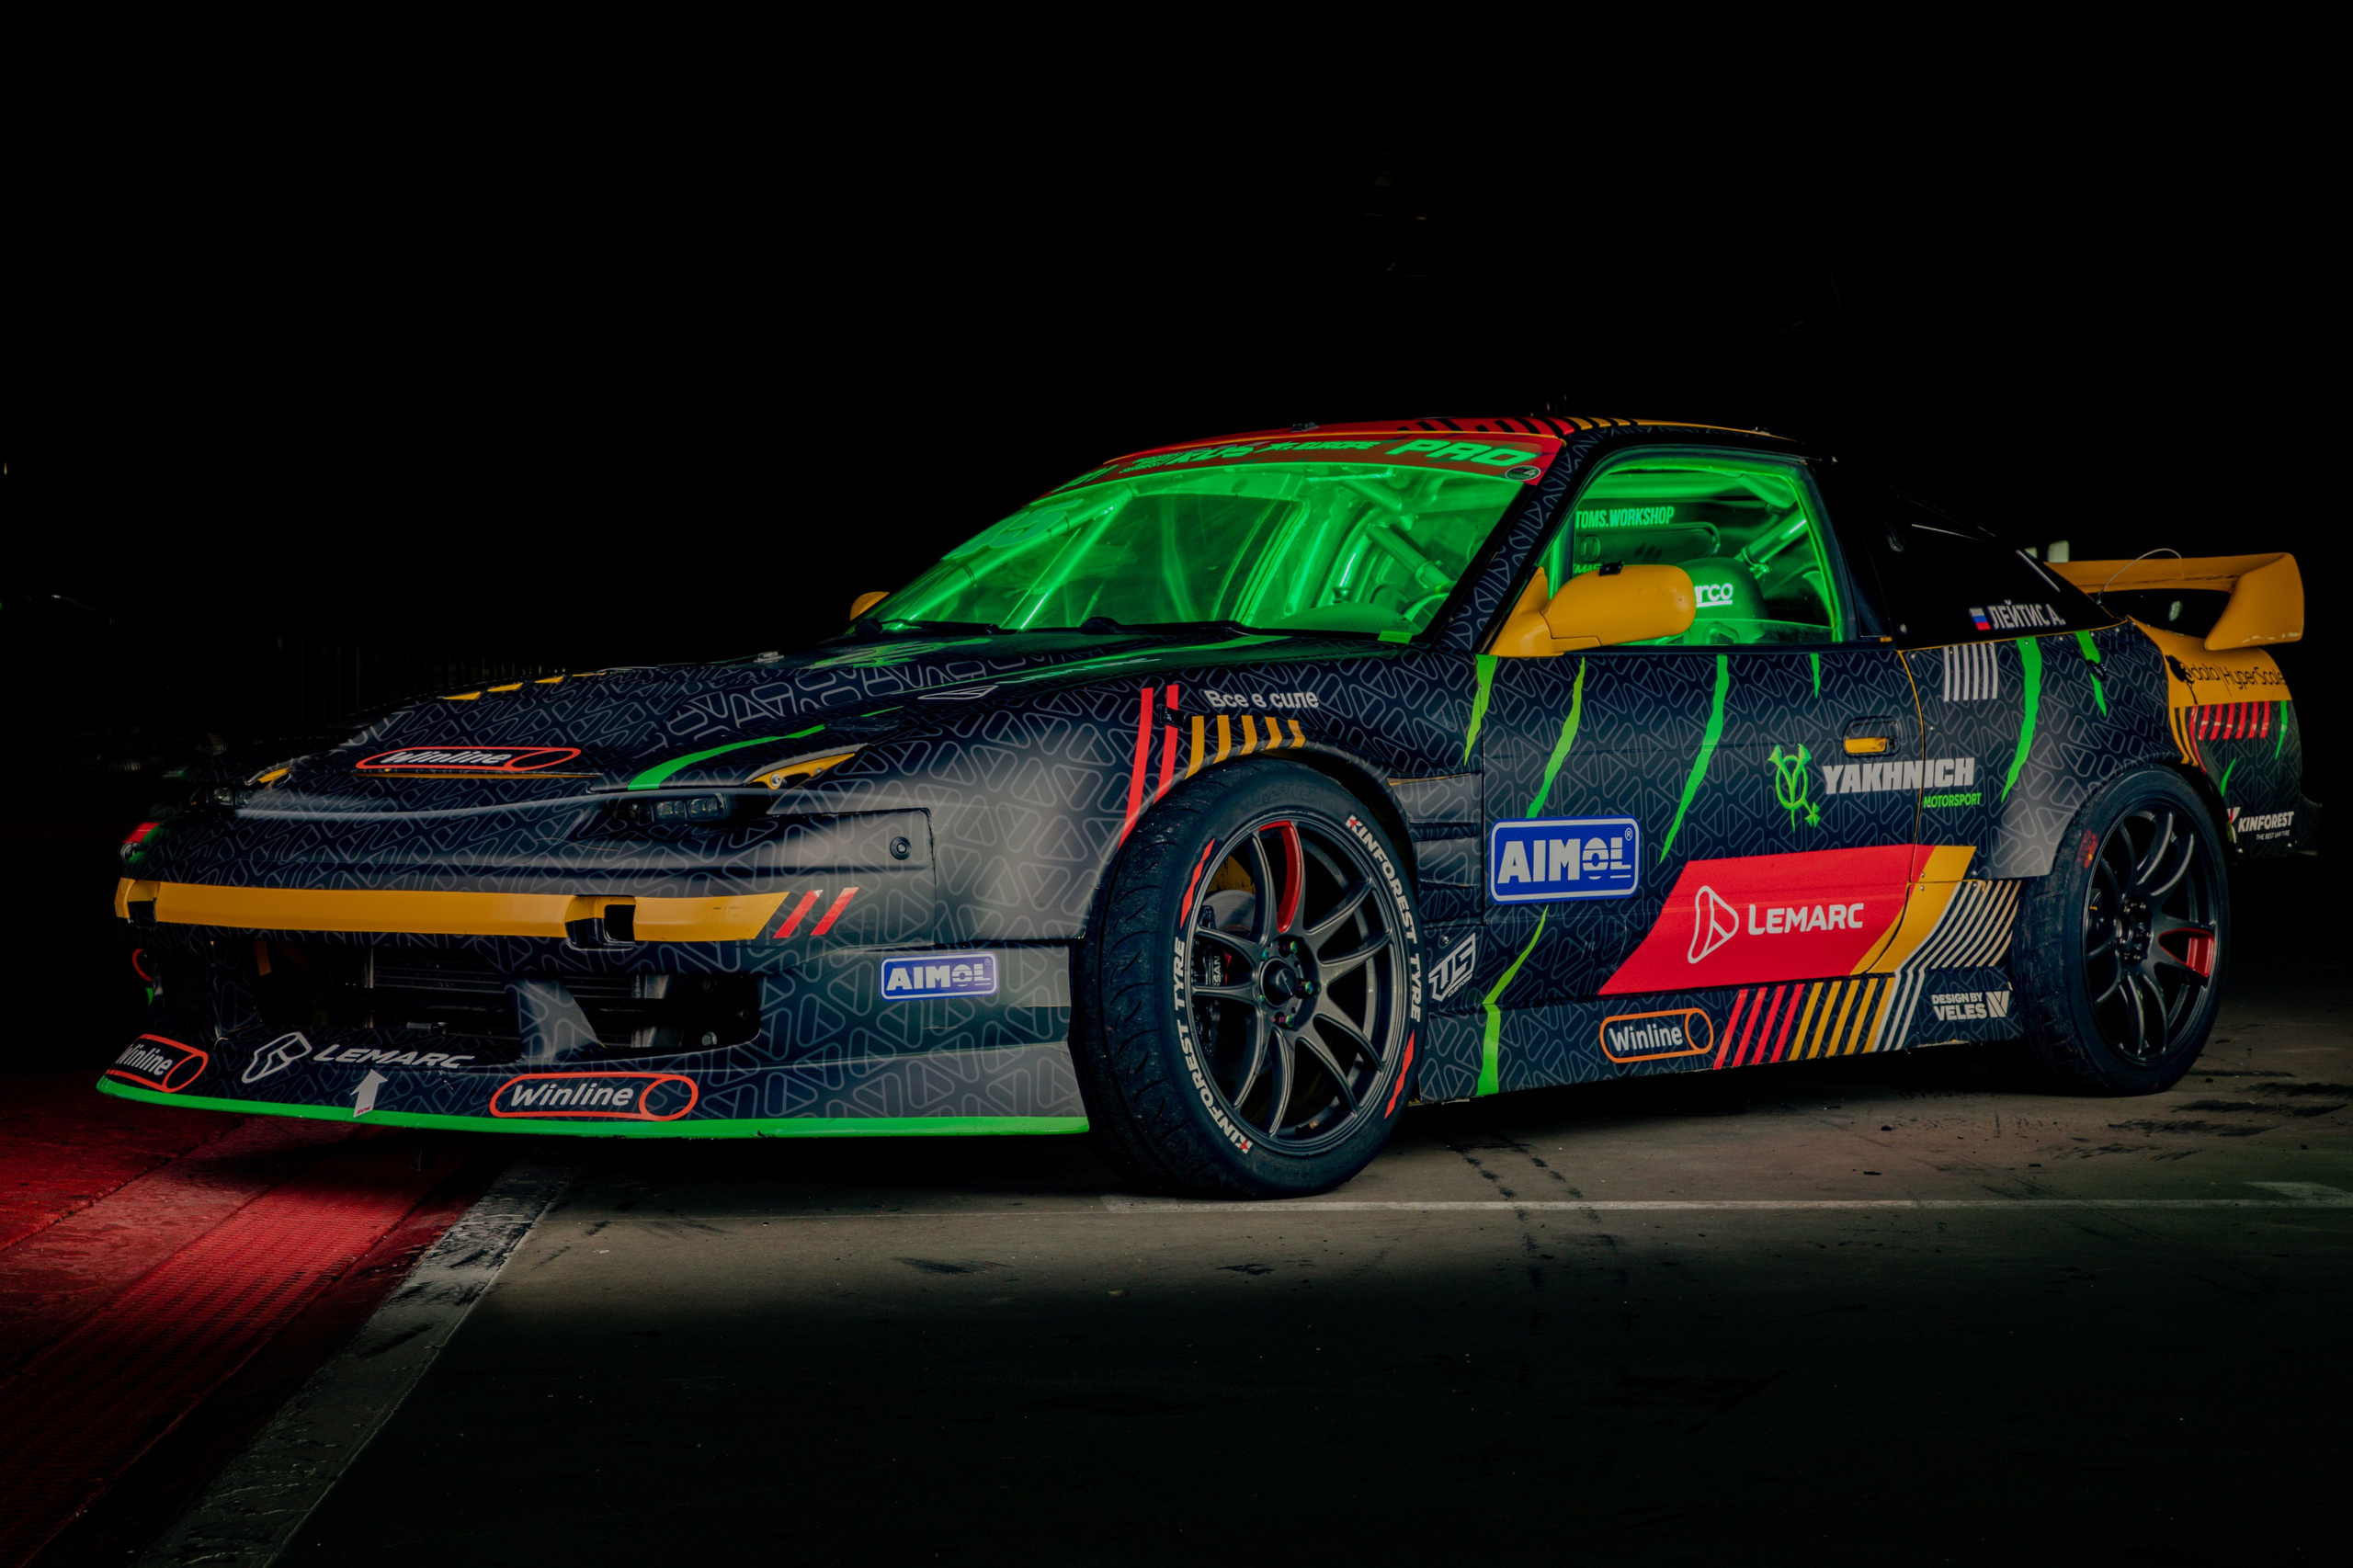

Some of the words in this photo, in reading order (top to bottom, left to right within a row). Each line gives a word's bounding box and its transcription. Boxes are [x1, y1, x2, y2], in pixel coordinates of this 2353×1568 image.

[1384, 438, 1538, 467] PRO
[1695, 583, 1733, 601] rco
[1987, 599, 2051, 630] ЛЕЙТИС
[1204, 690, 1249, 708] Все
[1268, 691, 1319, 709] силе
[380, 752, 512, 764] Winline
[1822, 757, 1975, 795] YAKHNICH
[1923, 792, 1982, 809] MOTORSPORT
[2237, 812, 2295, 833] KINFOREST
[1346, 814, 1417, 945] KINFOREST
[1408, 952, 1422, 1023] TYRE
[1748, 903, 1864, 936] LEMARC
[1173, 937, 1186, 1010] TYRE
[1931, 994, 1969, 1005] DESIGN
[1970, 992, 1983, 1003] BY
[1933, 1003, 1987, 1021] VELES
[1608, 1023, 1683, 1051] Winline
[313, 1043, 476, 1069] LEMARC
[510, 1083, 633, 1107] Winline
[1176, 1019, 1254, 1154] KINFOREST
